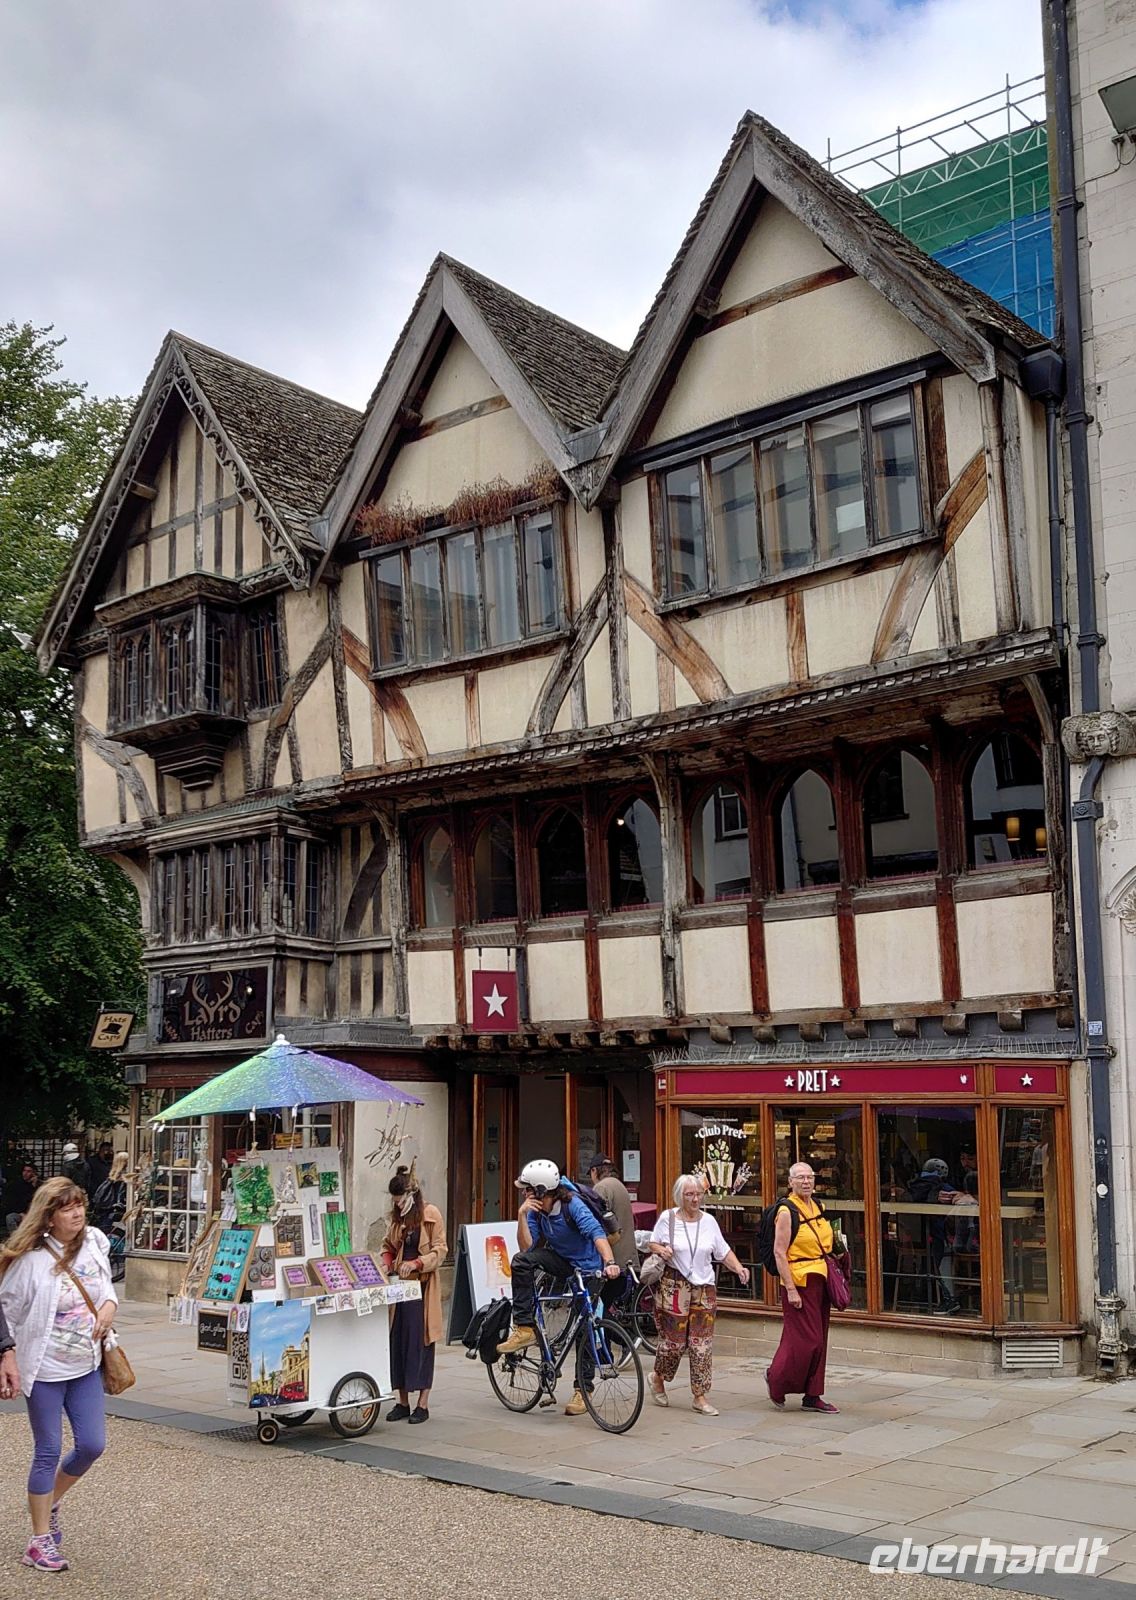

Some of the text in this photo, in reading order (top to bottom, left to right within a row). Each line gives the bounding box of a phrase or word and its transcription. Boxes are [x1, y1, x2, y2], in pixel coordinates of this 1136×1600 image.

[104, 1015, 127, 1023] Hats
[98, 1033, 121, 1042] Caps
[191, 1027, 233, 1042] Hatters
[797, 1069, 828, 1092] PRET
[698, 1124, 721, 1139] Club
[722, 1124, 743, 1139] Pret
